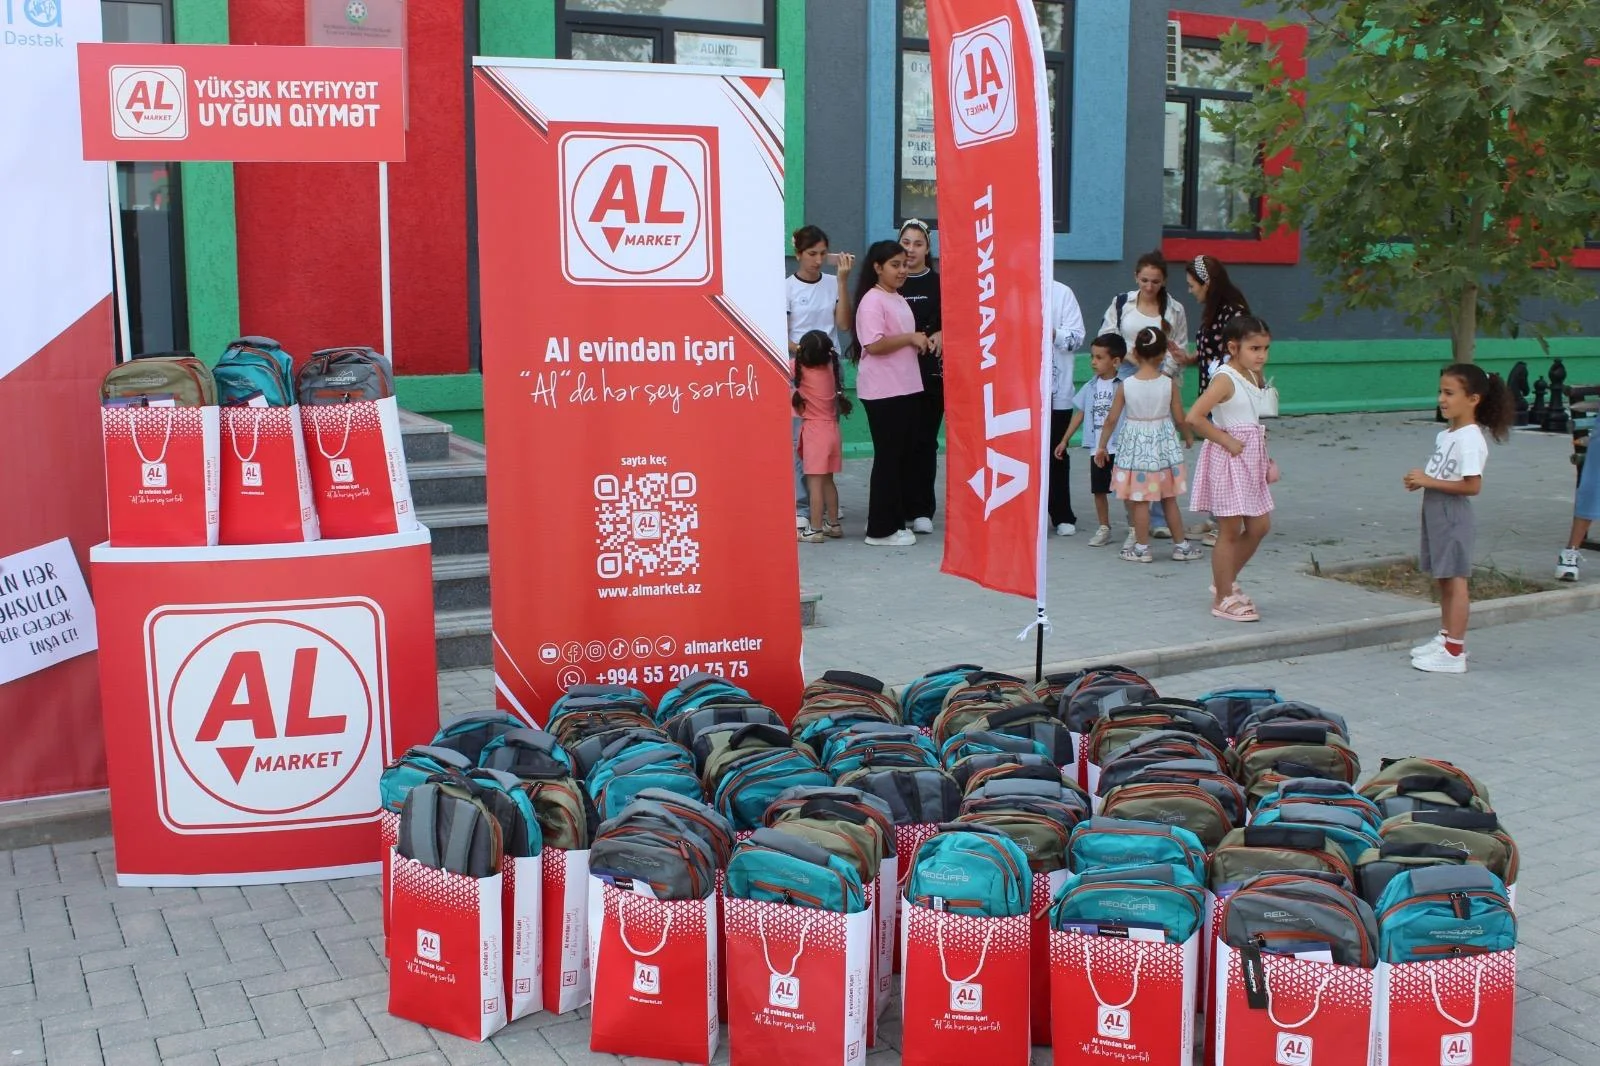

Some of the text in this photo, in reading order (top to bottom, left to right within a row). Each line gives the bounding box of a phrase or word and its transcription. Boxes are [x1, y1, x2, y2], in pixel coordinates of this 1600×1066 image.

[5, 30, 64, 47] Dəstək
[700, 42, 738, 56] ADINIZI
[194, 76, 272, 98] YÜKSƏK
[125, 80, 174, 110] AL
[143, 114, 172, 122] MARKET
[198, 98, 282, 127] UYĞUN
[588, 164, 685, 224] AL
[624, 234, 682, 246] MARKET
[544, 336, 735, 366] Al evindən içəri
[688, 364, 760, 402] sərfəli
[335, 463, 348, 473] AL
[620, 455, 668, 468] sayta keç
[147, 468, 162, 478] AL
[245, 467, 258, 477] AL
[638, 516, 656, 528] AL
[22, 562, 58, 588] HƏR
[598, 583, 702, 598] www.almarket.az
[22, 608, 74, 636] GƏLƏCƏK
[62, 628, 80, 644] ET!
[684, 637, 763, 655] almarketler
[596, 668, 638, 686] +994
[644, 665, 664, 683] 55
[704, 662, 724, 678] 75
[730, 660, 748, 678] 75
[195, 647, 347, 742] AL
[254, 750, 343, 772] MARKET
[422, 936, 436, 950] AL
[639, 970, 654, 983] AL
[776, 982, 794, 996] AL
[956, 988, 976, 1000] AL
[1104, 1014, 1124, 1028] AL
[1284, 1040, 1306, 1055] AL
[1448, 1040, 1467, 1054] AL
